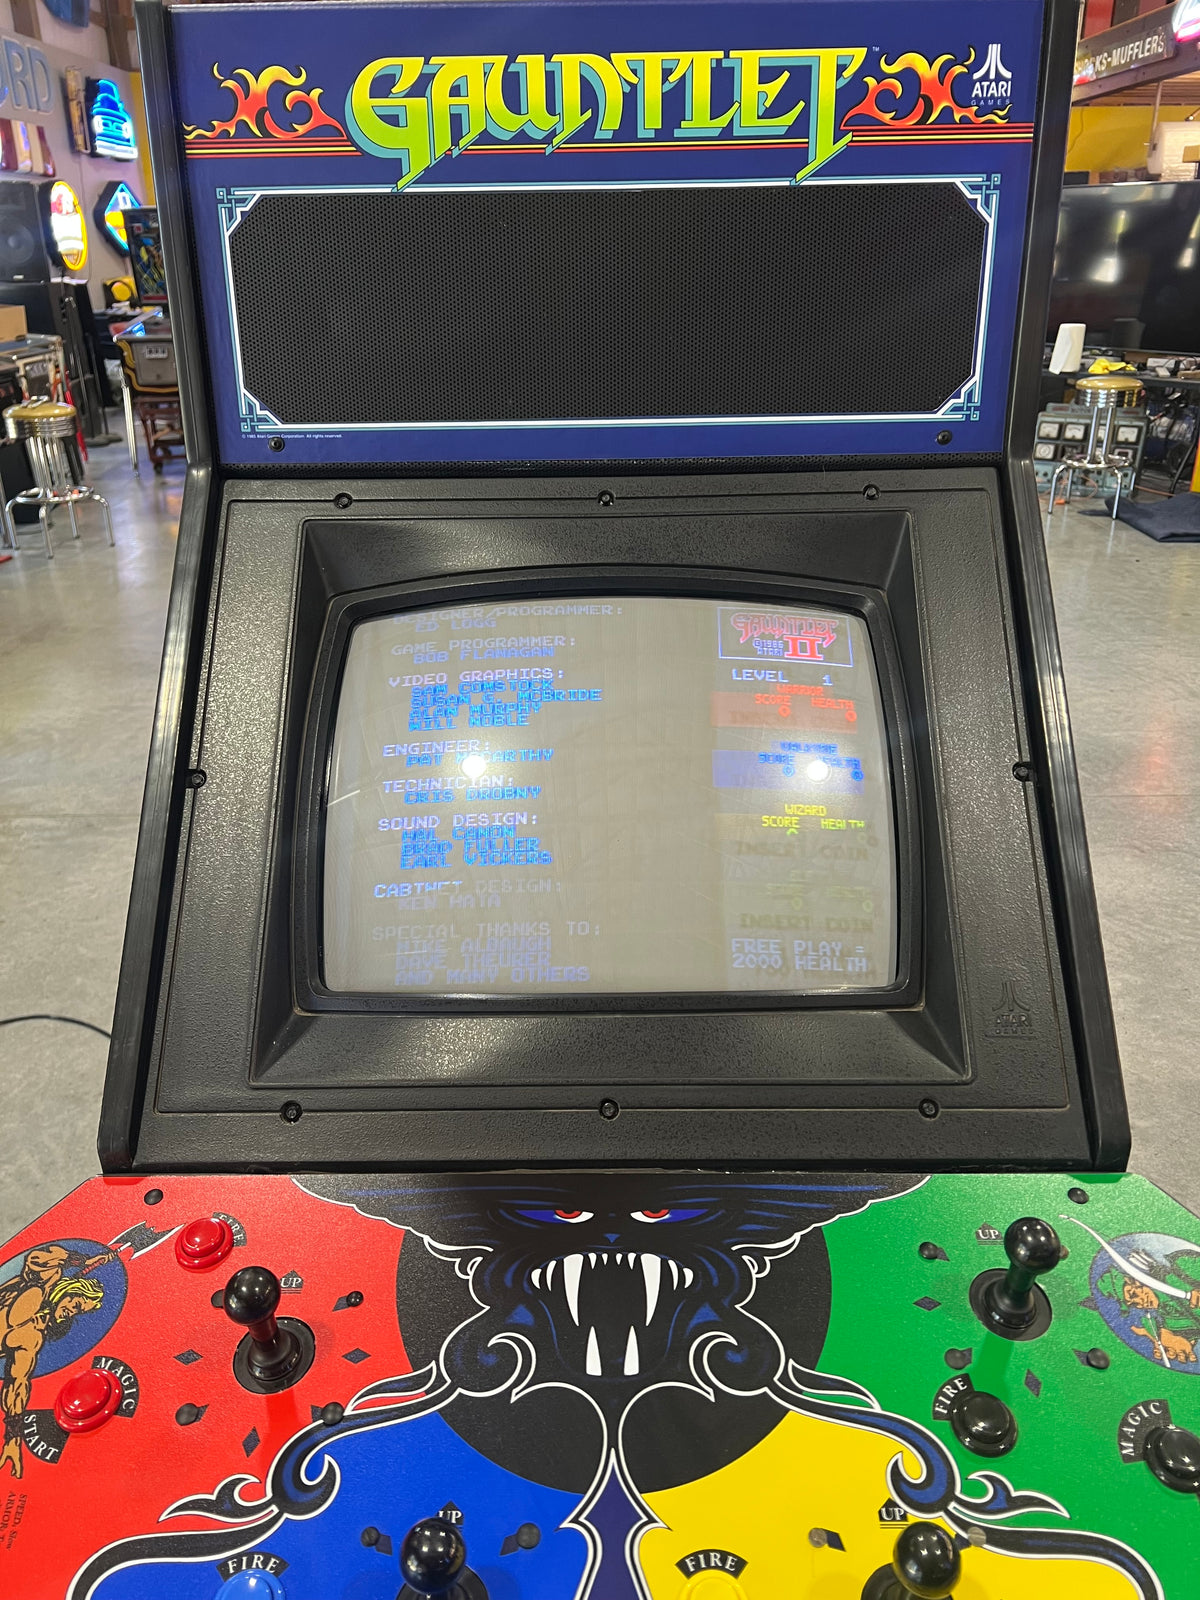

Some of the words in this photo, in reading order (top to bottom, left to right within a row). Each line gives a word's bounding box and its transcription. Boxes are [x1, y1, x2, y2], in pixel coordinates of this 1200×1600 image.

[0, 37, 53, 114] RD
[972, 81, 1012, 98] ATARI
[346, 46, 868, 192] GAUNTLET
[415, 621, 439, 632] ED
[451, 617, 497, 630] LOGG
[731, 612, 839, 648] GAUNTLET
[391, 642, 438, 656] GAME
[449, 636, 576, 650] PROGRAMMER:
[413, 651, 449, 664] BOB
[460, 646, 555, 660] FLANAGAN
[388, 672, 447, 688] VIDEO
[459, 667, 564, 682] GRAPHICS:
[732, 668, 790, 683] LEVEL
[822, 674, 834, 686] 1
[412, 684, 449, 698] SAM
[458, 679, 554, 694] COMSTOCK
[776, 684, 824, 696] WARRIOR
[410, 694, 471, 709] SUSAN
[482, 692, 502, 704] G.
[517, 688, 602, 702] MCBRIDE
[754, 693, 792, 706] SCORE
[810, 698, 855, 711] HEALTH
[409, 706, 459, 720] ALAN
[469, 702, 543, 716] MURPHY
[408, 718, 457, 732] WILL
[468, 714, 530, 728] NOBLE
[382, 739, 490, 757] ENGINEER:
[406, 754, 443, 768] PAT
[758, 752, 795, 765] SCORE
[382, 776, 514, 793] TECHNICIAN:
[404, 790, 455, 804] CRIS
[466, 786, 542, 801] DROBNY
[784, 804, 828, 817] WIZARD
[378, 816, 440, 832] SOUND
[452, 812, 538, 827] DESIGN:
[762, 816, 800, 828] SCORE
[402, 828, 440, 842] HAL
[452, 826, 516, 840] CANON
[400, 840, 453, 856] BRAD
[464, 837, 542, 852] FULLER
[400, 854, 452, 870] EARL
[464, 850, 553, 866] VICKERS
[474, 878, 562, 894] DESIGN:
[372, 922, 460, 941] SPECIAL
[476, 921, 551, 938] THANKS
[396, 938, 447, 954] MIKE
[732, 938, 782, 954] FREE
[794, 940, 843, 956] PLAY
[395, 953, 448, 970] DAVE
[464, 951, 552, 969] THEURER
[732, 954, 783, 969] 2000
[795, 956, 868, 972] HEALTH
[394, 969, 434, 986] AND
[446, 967, 500, 985] MANY
[510, 966, 590, 983] OTHERS
[978, 1228, 999, 1240] UP
[280, 1277, 302, 1288] UP
[96, 1357, 137, 1410] MAGIC
[934, 1377, 968, 1415] FIRE
[24, 1414, 59, 1460] START
[1120, 1402, 1163, 1456] MAGIC
[12, 1494, 28, 1527] SPEED,
[438, 1510, 462, 1524] UP
[880, 1507, 905, 1521] UP
[227, 1554, 280, 1574] FIRE
[684, 1550, 738, 1572] FIRE
